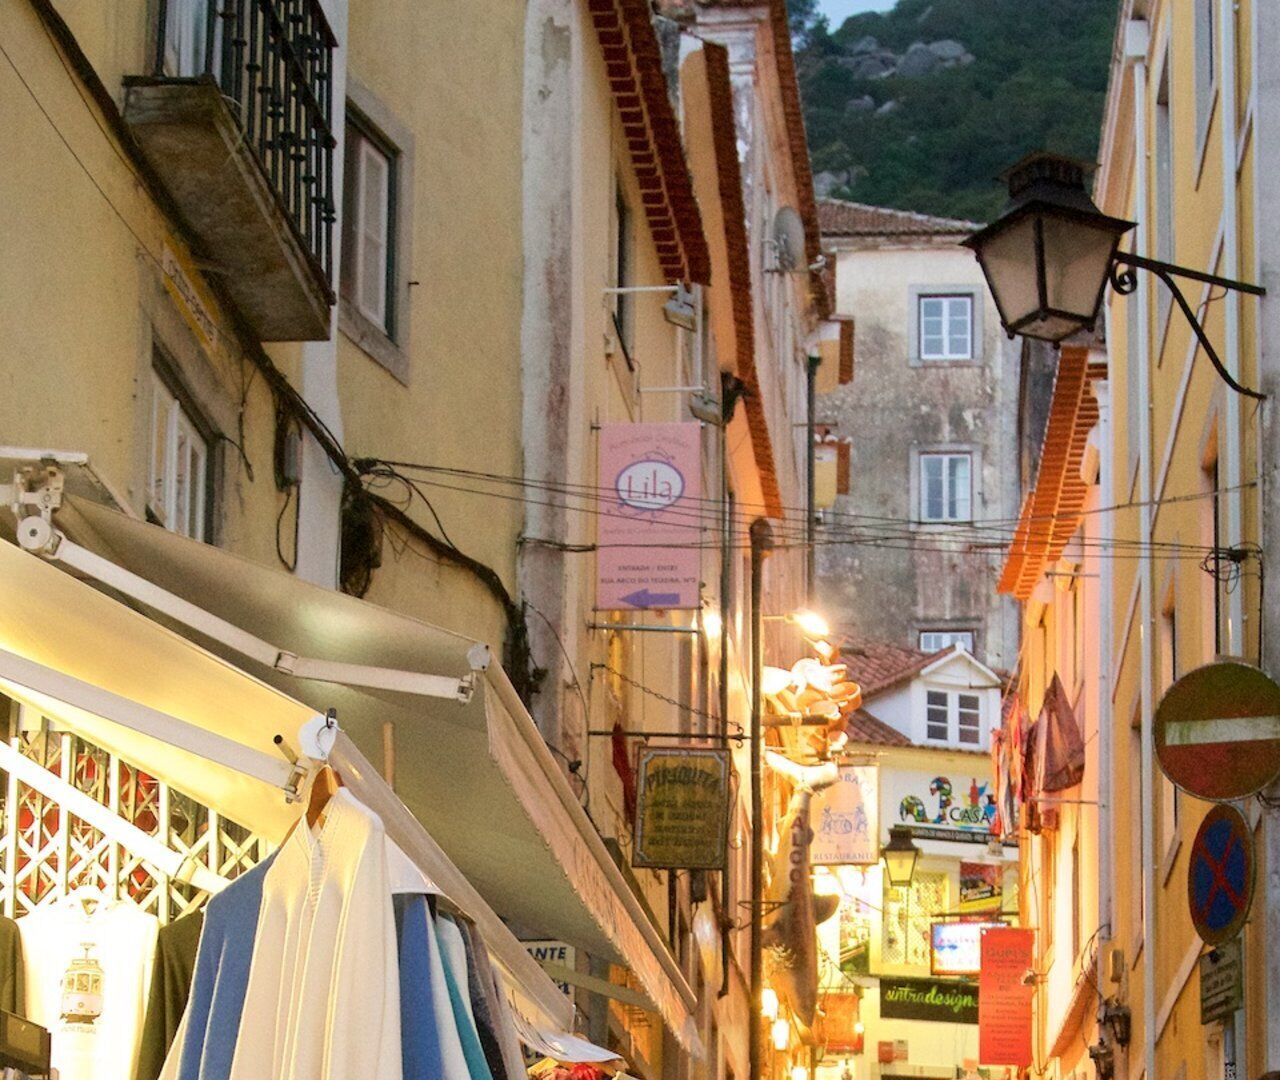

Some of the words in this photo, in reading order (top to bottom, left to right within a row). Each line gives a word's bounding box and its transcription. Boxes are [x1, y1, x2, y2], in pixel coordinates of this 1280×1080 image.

[629, 470, 672, 500] Lila
[949, 806, 991, 824] CASA
[526, 946, 567, 961] ANTE
